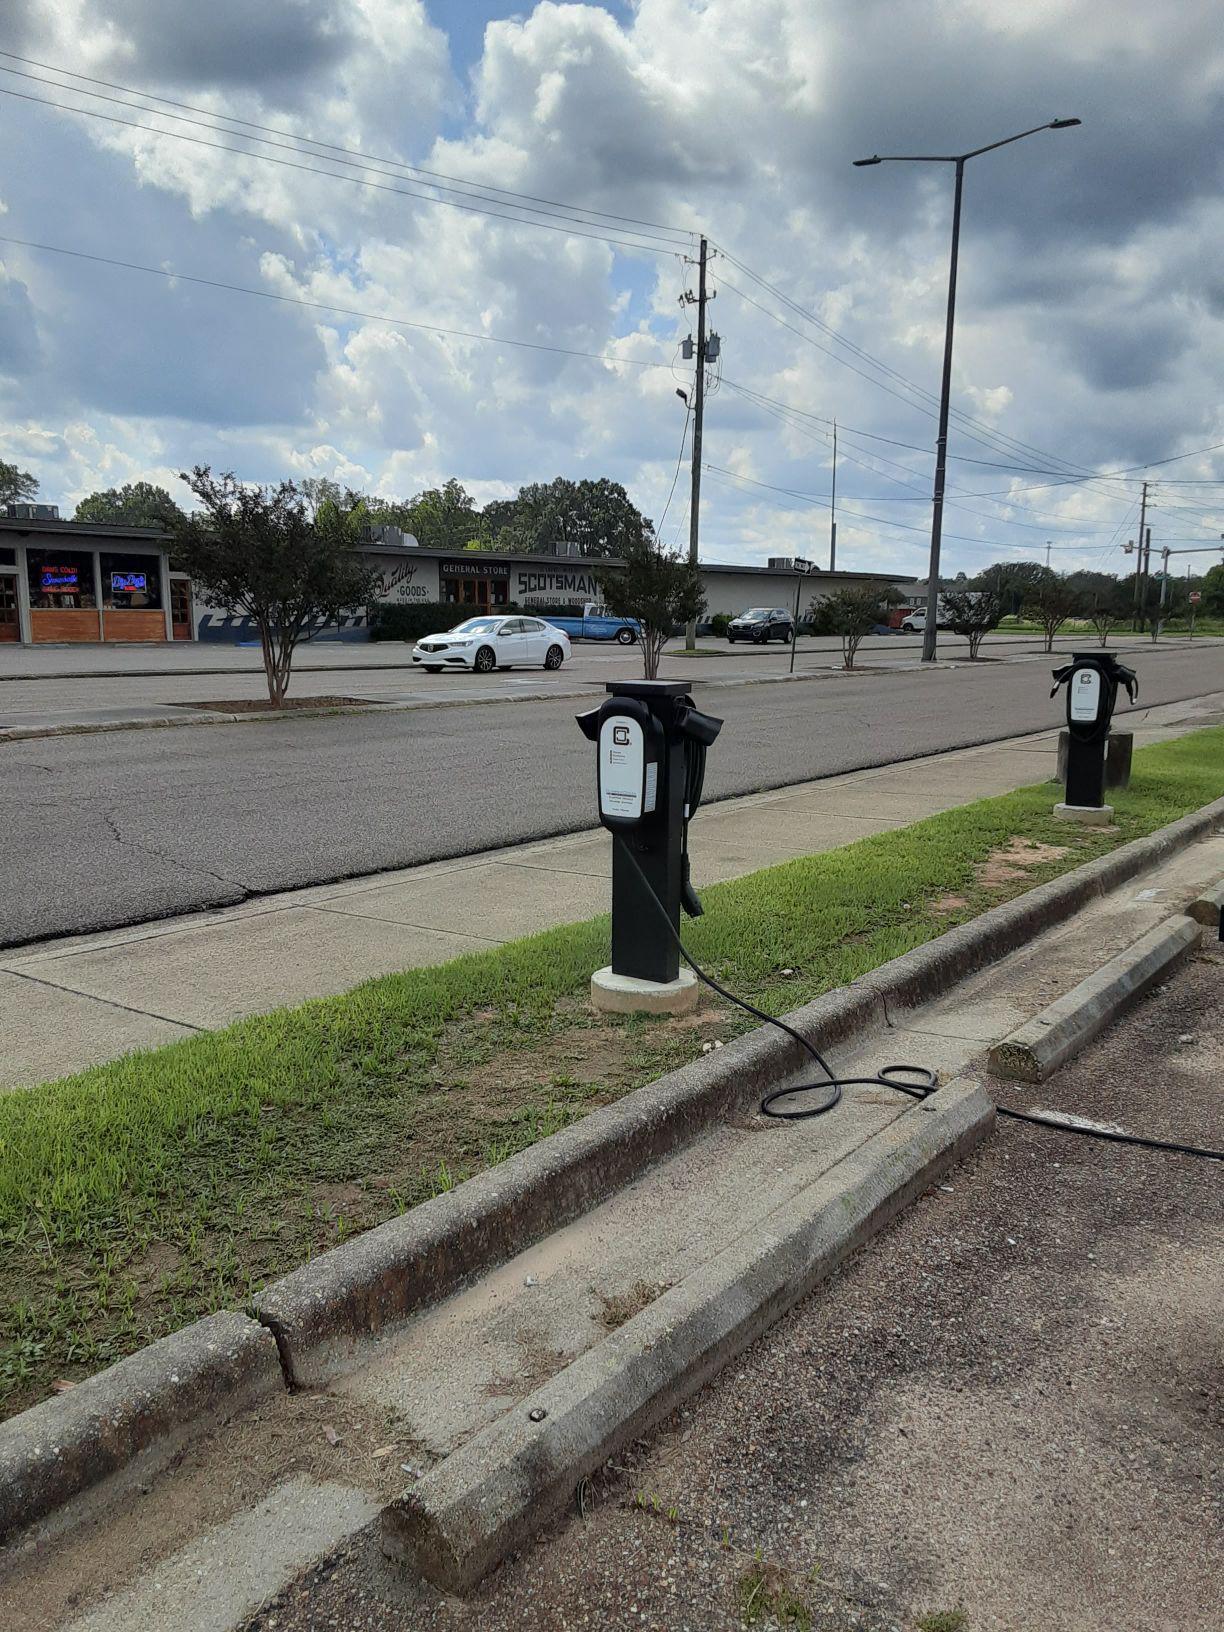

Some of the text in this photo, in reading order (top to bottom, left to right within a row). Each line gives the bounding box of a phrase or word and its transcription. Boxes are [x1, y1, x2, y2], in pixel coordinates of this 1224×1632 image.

[443, 564, 508, 575] GENERAL STORE
[518, 572, 598, 596] SCOTSMAN
[400, 585, 427, 597] GOODS
